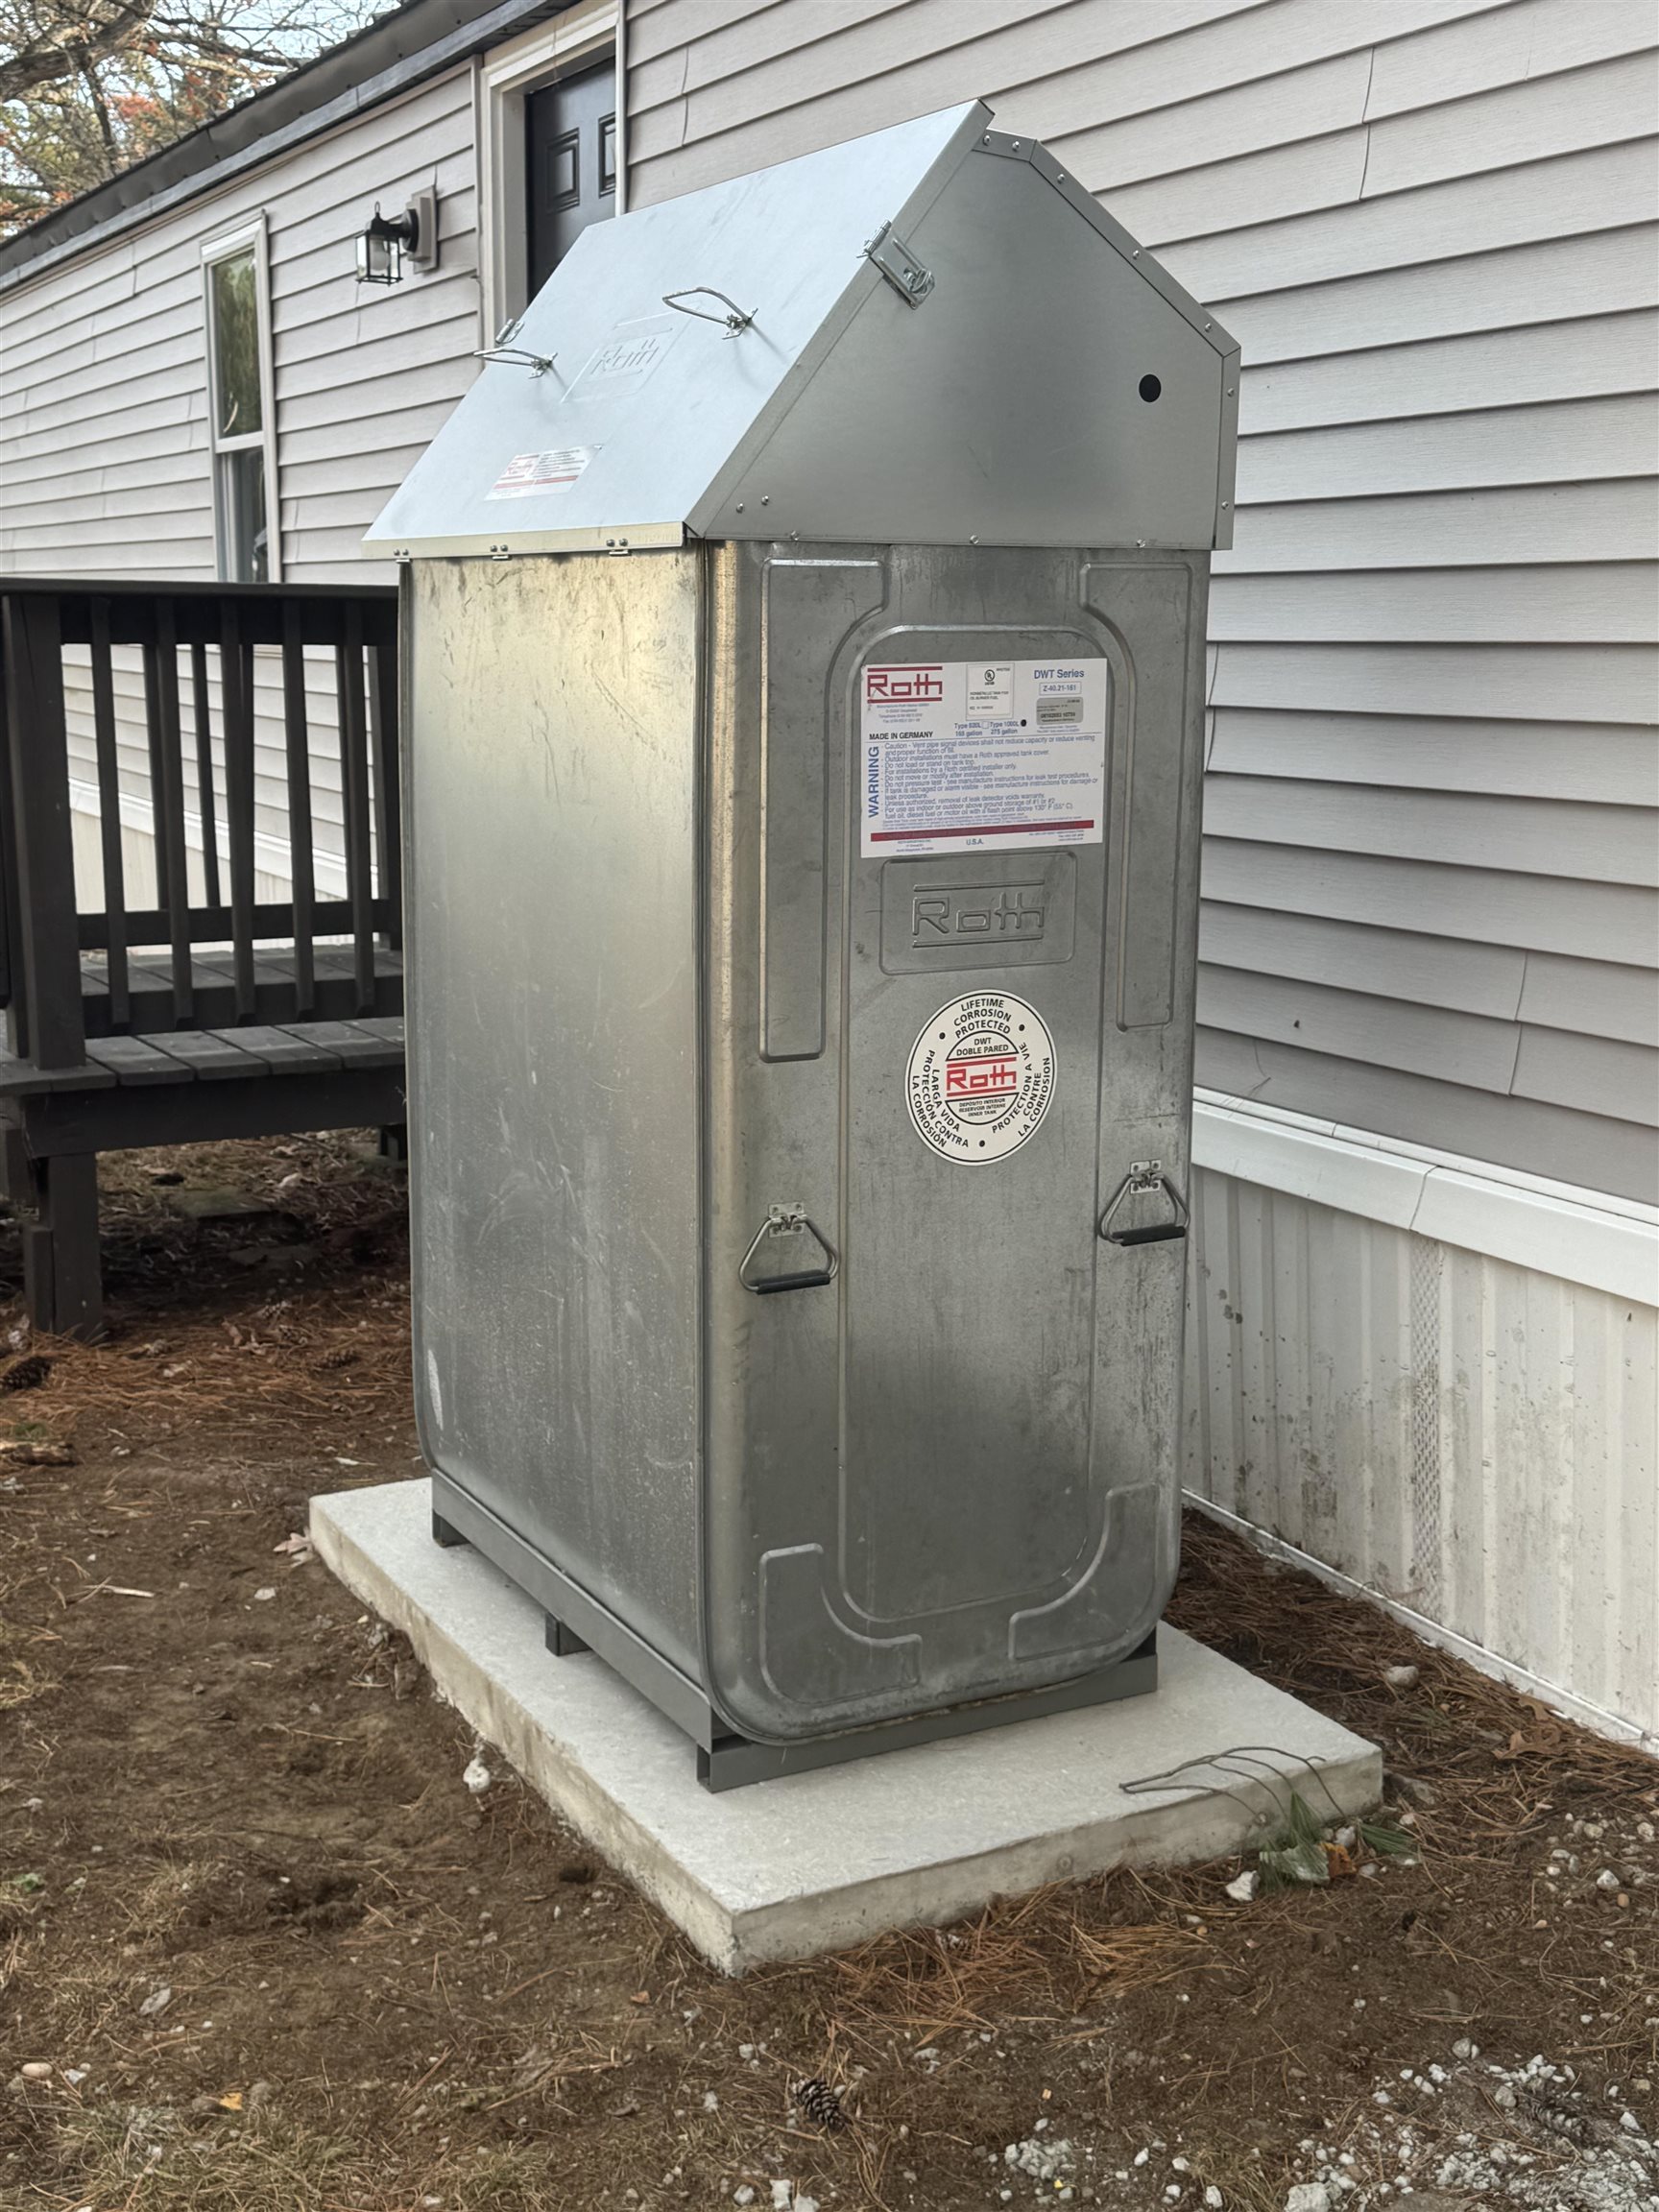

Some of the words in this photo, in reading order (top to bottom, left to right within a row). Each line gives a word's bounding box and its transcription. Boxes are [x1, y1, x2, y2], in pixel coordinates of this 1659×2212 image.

[1034, 670, 1055, 679] DWT
[1057, 669, 1084, 678] Series
[867, 673, 943, 697] Roth
[900, 731, 933, 739] GERMANY
[868, 746, 879, 818] WARNING
[913, 892, 1045, 935] Roth
[961, 998, 1004, 1012] LIFETIME
[953, 1008, 1012, 1026] CORROSION
[955, 1020, 1011, 1039] PROTECTED
[956, 1046, 982, 1056] DOBLE
[983, 1045, 1008, 1054] PARED
[974, 1038, 992, 1046] DWT
[1019, 1042, 1030, 1060] VIE
[1024, 1063, 1033, 1071] A
[912, 1075, 920, 1090] LA
[947, 1065, 1017, 1091] Roth
[922, 1049, 937, 1119] PROTECCIÓN
[934, 1119, 969, 1147] CONTRA
[932, 1069, 943, 1108] LARGA
[941, 1109, 960, 1132] VIDA
[992, 1076, 1032, 1133] PROTECTION
[1018, 1124, 1031, 1138] LA
[1030, 1057, 1050, 1122] CORROSION
[1023, 1072, 1042, 1117] CONTRE
[913, 1093, 947, 1148] CORROSIÓN
